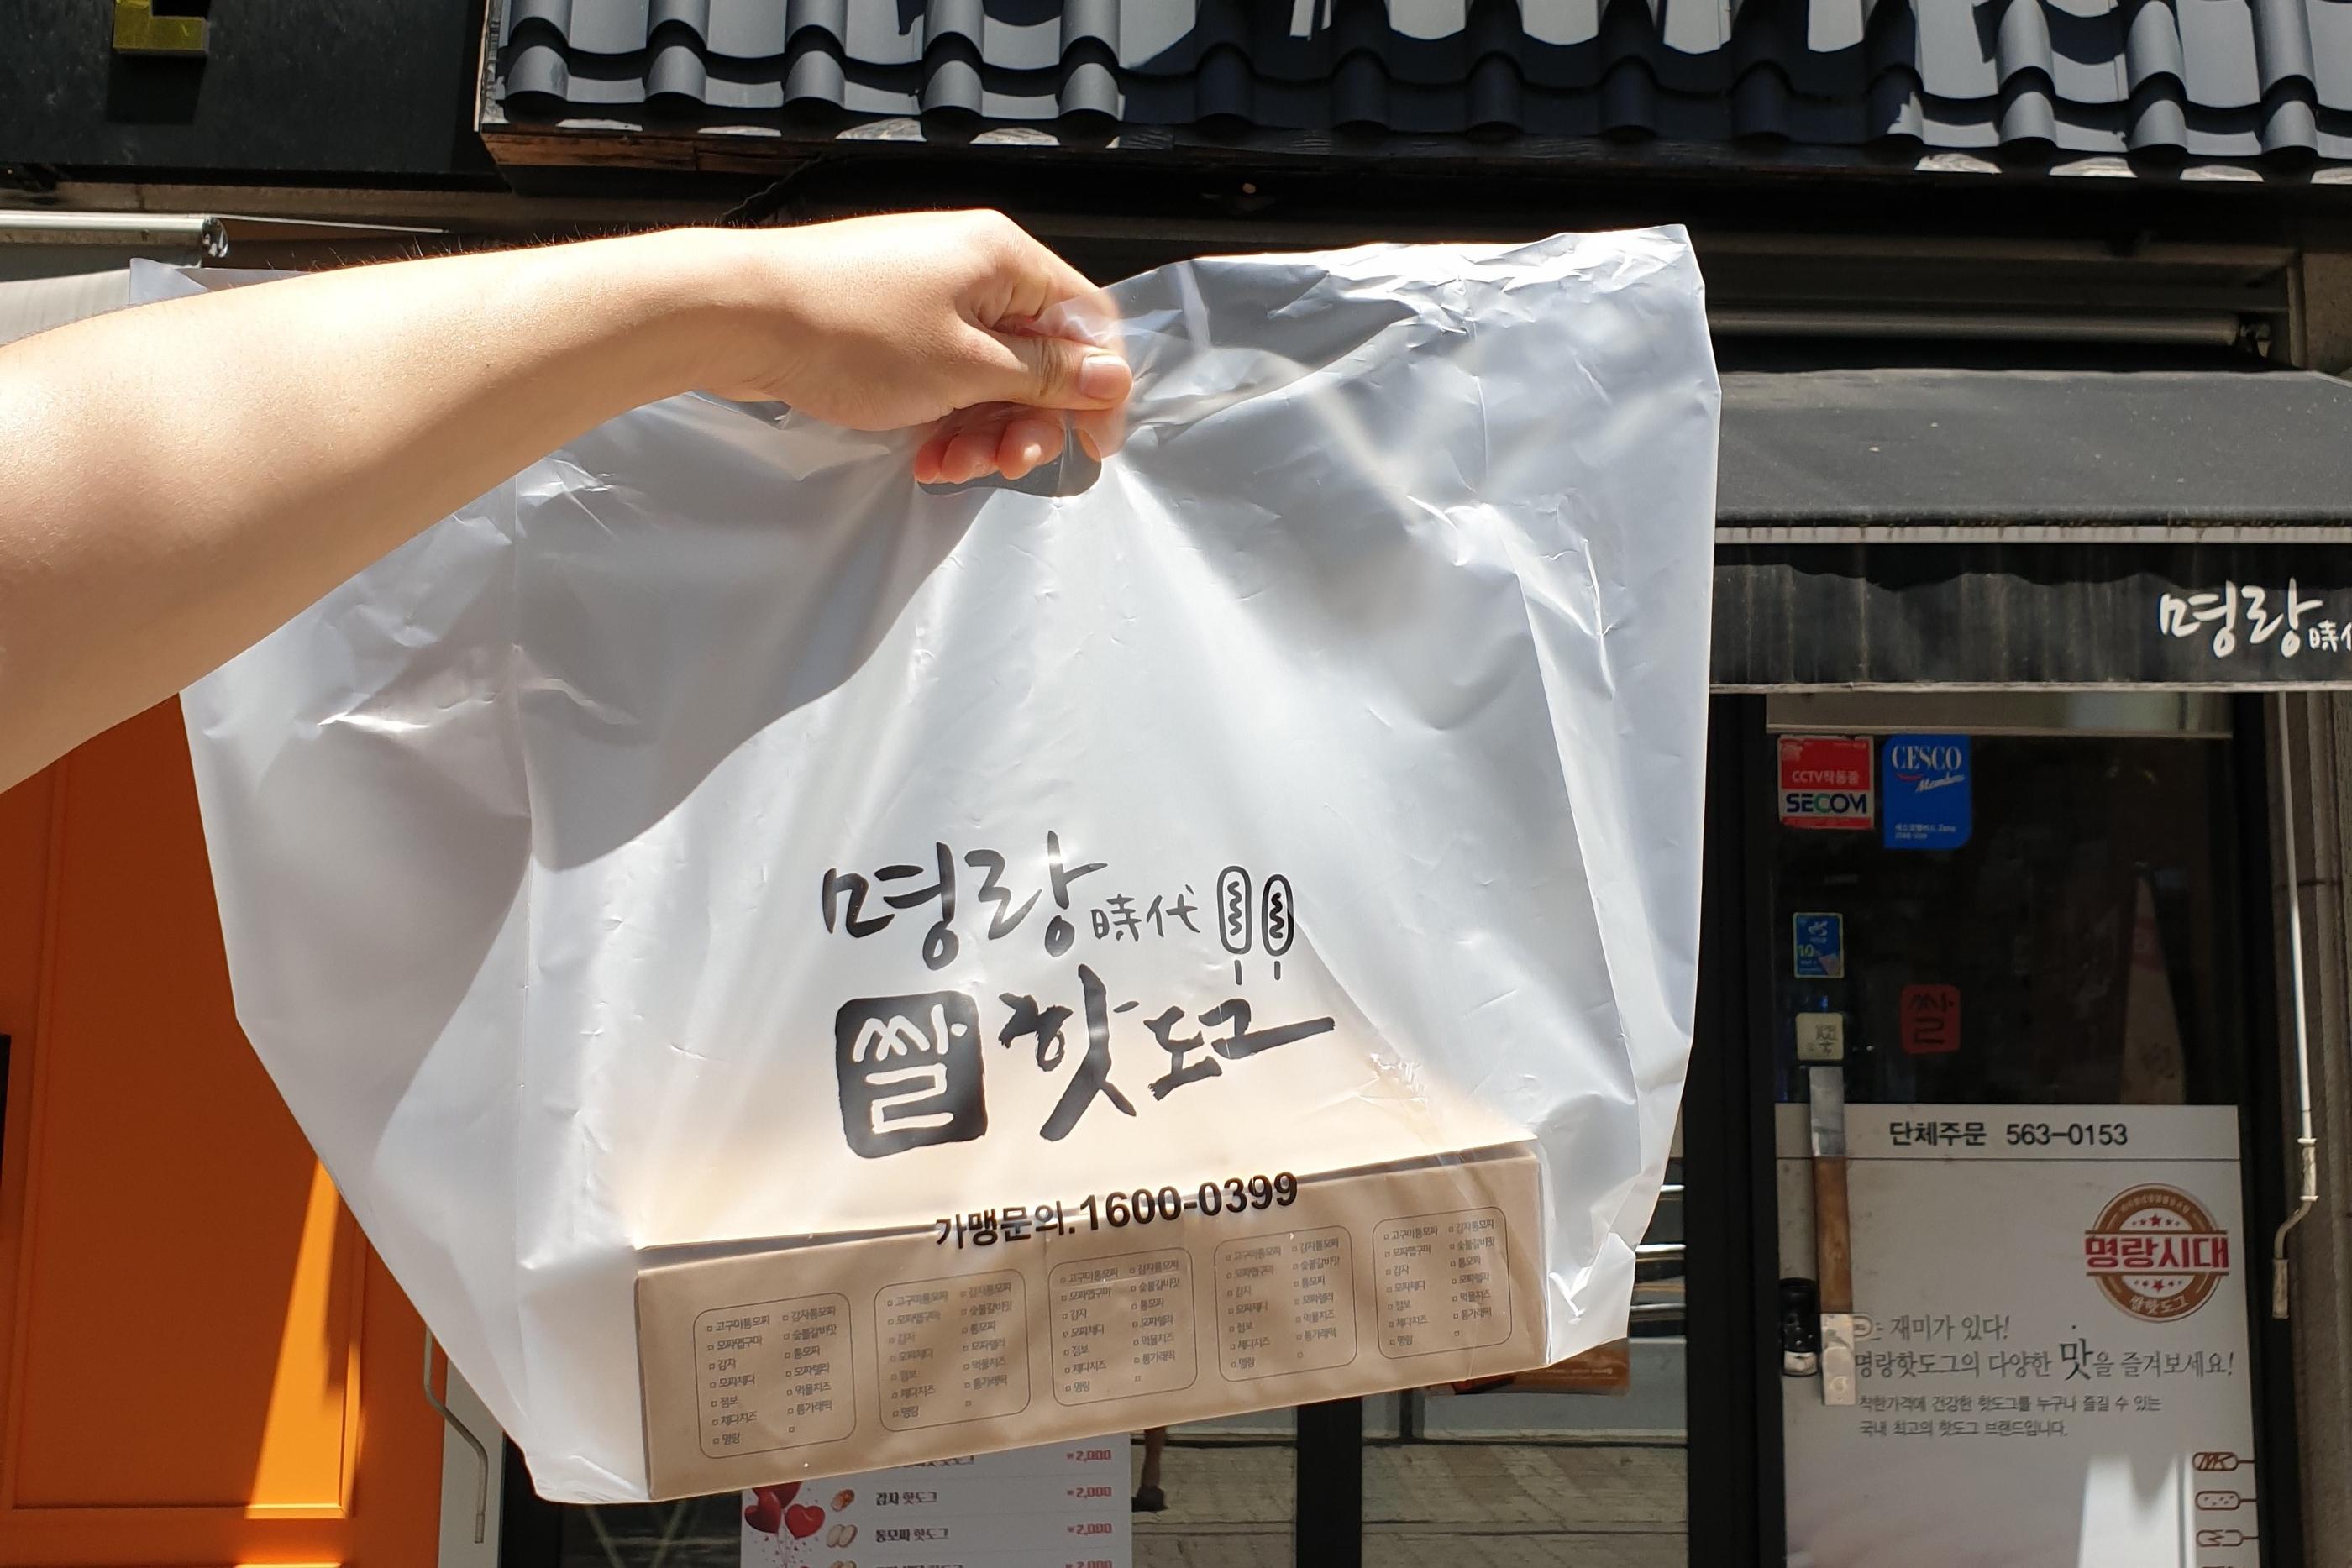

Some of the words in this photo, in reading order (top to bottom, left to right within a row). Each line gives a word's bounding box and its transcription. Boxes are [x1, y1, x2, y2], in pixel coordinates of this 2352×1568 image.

[2159, 576, 2323, 658] 명랑
[1892, 745, 1962, 770] CESCO
[1786, 793, 1866, 814] SECOM
[822, 830, 1108, 971] 명랑
[998, 963, 1336, 1143] 핫도그
[1889, 1121, 1987, 1146] 단체주문
[2006, 1122, 2129, 1146] 563-0153
[2085, 1236, 2229, 1269] 명랑시대
[1890, 1314, 1956, 1341] 재미가
[1961, 1314, 2010, 1341] 있다!
[1855, 1350, 1979, 1378] 명랑핫도그의
[1988, 1350, 2052, 1378] 다양한
[2060, 1337, 2114, 1381] 맛을
[2121, 1350, 2234, 1378] 즐겨보세요!
[1932, 1395, 1972, 1412] 건강한
[1977, 1395, 2031, 1412] 핫도그를
[2036, 1395, 2076, 1413] 누구나
[2082, 1395, 2110, 1412] 즐길
[2114, 1395, 2129, 1413] 수
[2134, 1394, 2163, 1412] 있는
[1859, 1420, 1887, 1435] 국내
[1893, 1420, 1933, 1437] 최고의
[1939, 1419, 1979, 1437] 핫도그
[903, 1492, 937, 1505] 핫도그
[914, 1528, 948, 1541] 핫도그
